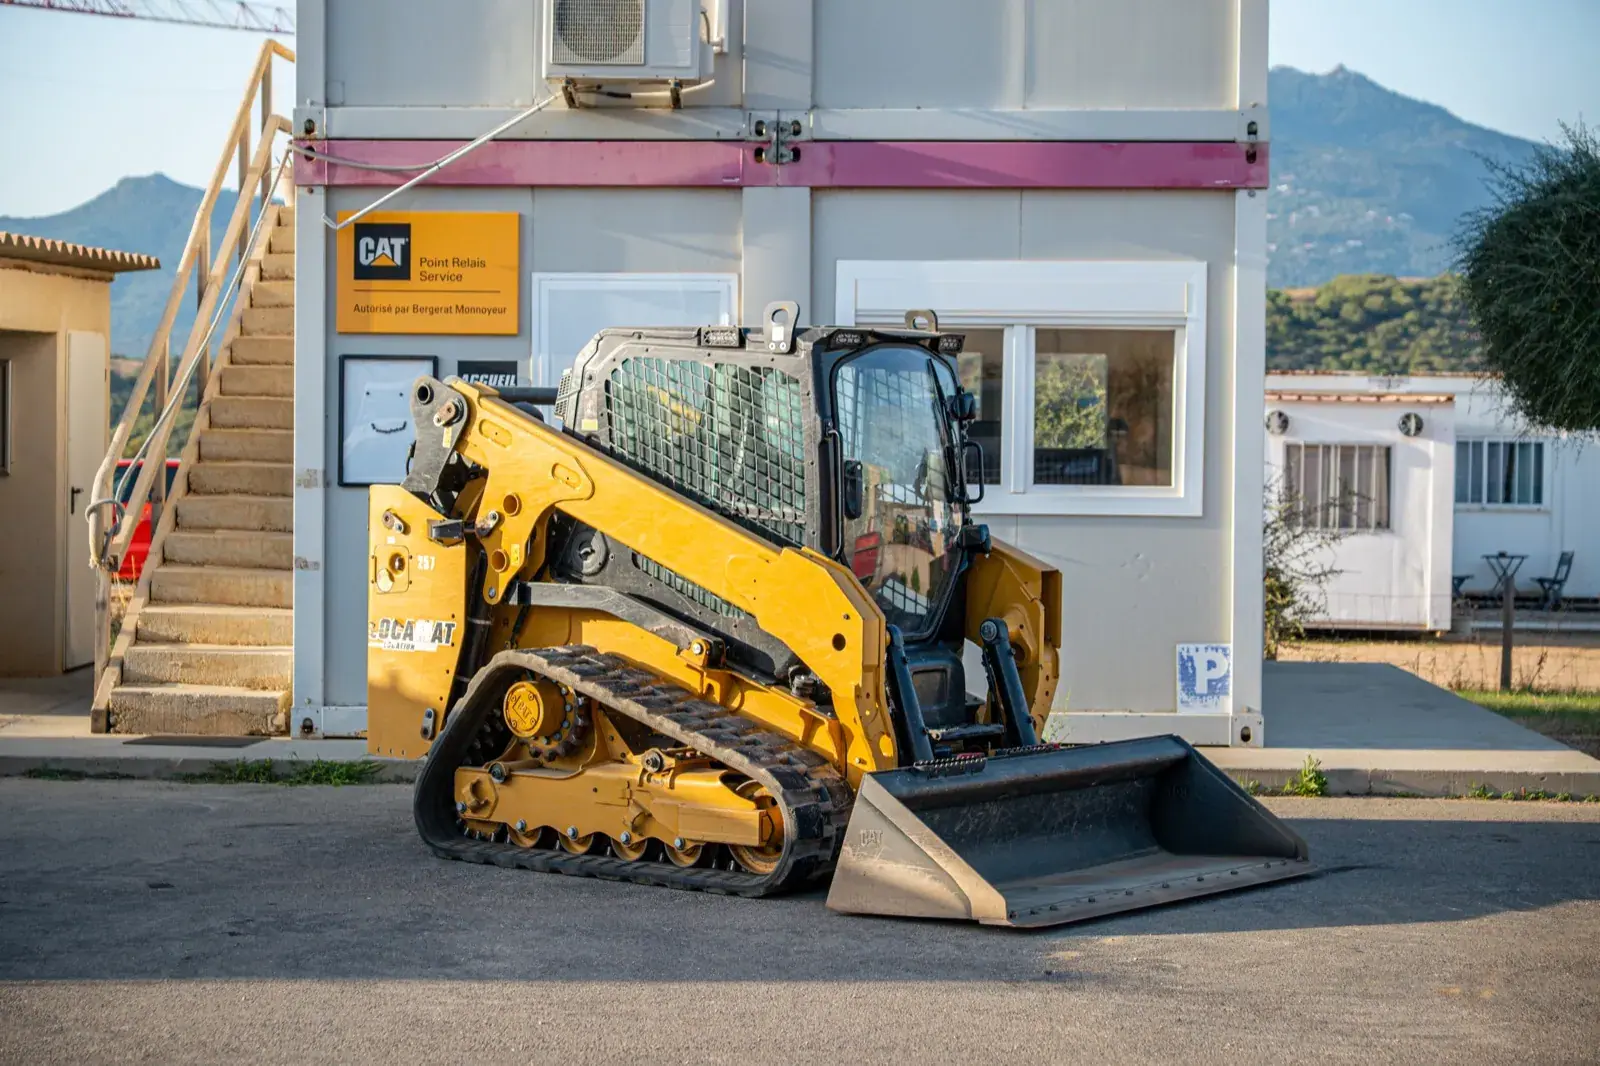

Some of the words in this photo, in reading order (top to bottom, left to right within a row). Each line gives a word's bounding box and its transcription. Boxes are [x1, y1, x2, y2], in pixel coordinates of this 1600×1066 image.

[359, 237, 406, 266] CAT
[420, 257, 448, 268] Point
[452, 257, 486, 268] Relais
[419, 271, 463, 282] Service
[353, 303, 392, 314] Autorisé
[394, 305, 409, 315] par
[412, 304, 453, 316] Bergerat
[455, 304, 507, 316] Monnoyeur
[1193, 652, 1228, 694] P
[860, 829, 883, 847] CAT
